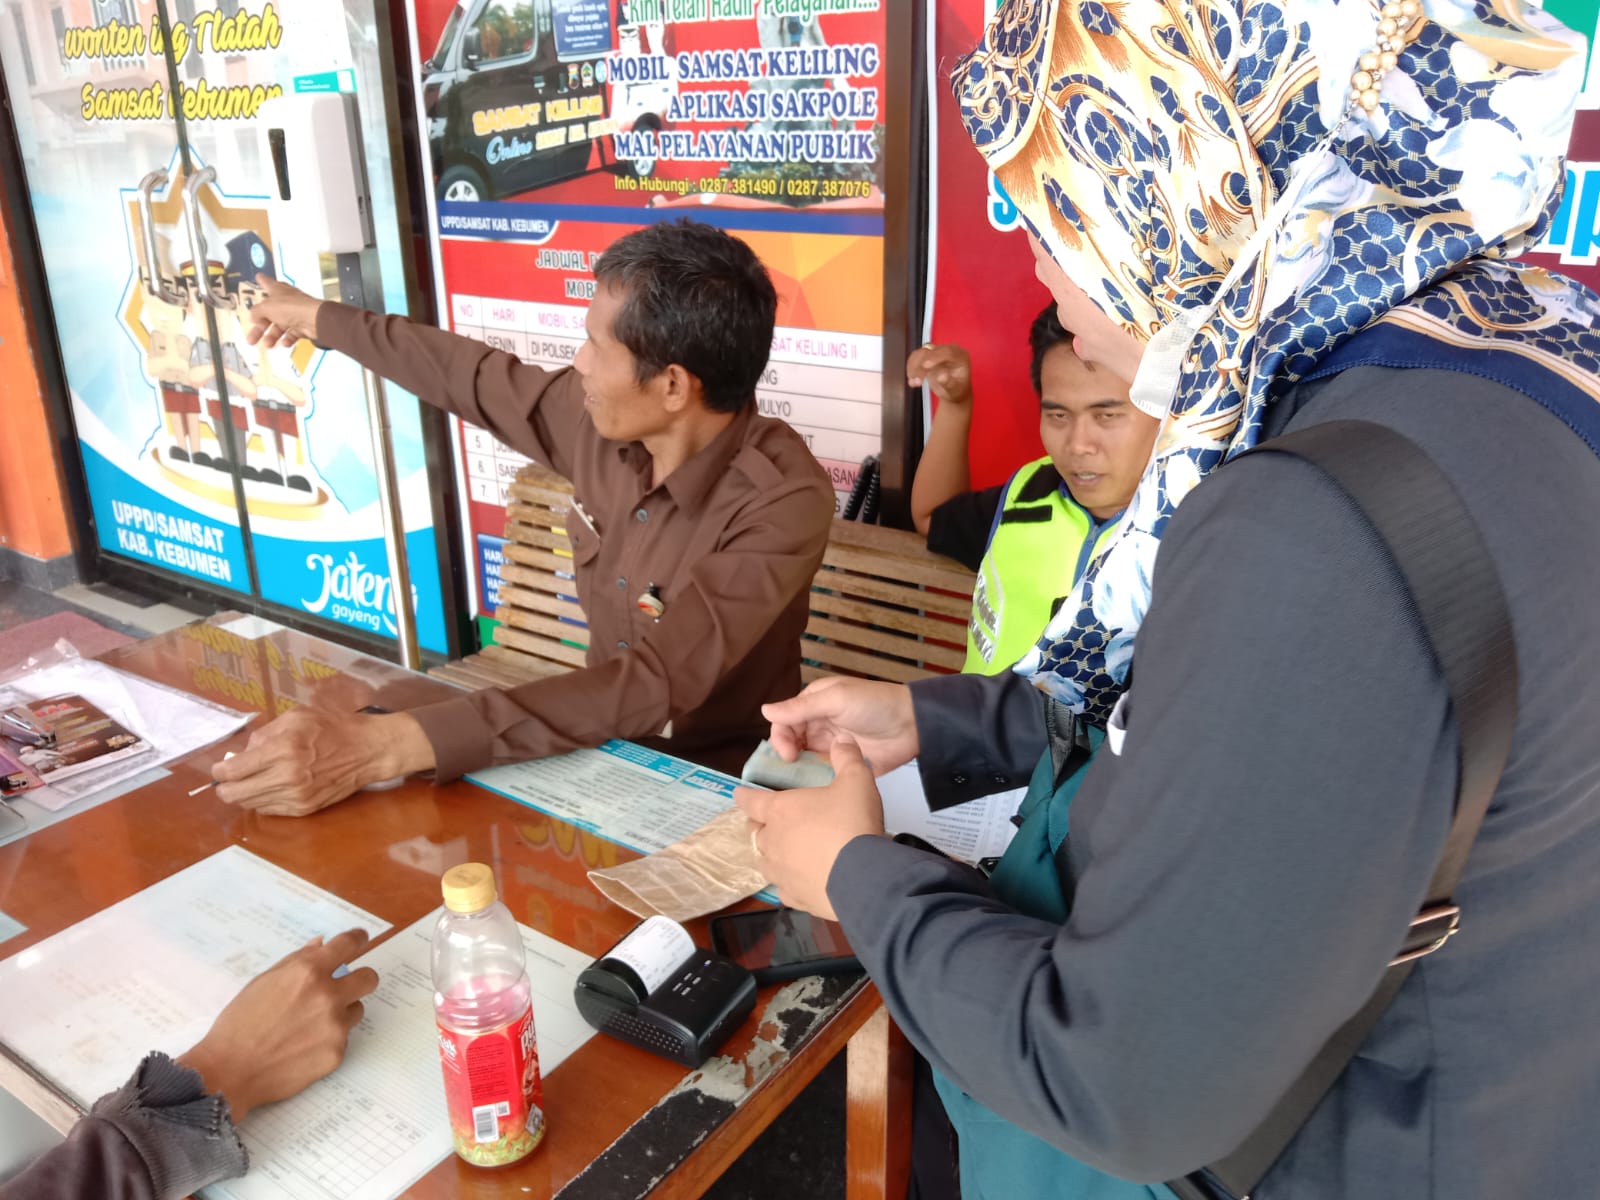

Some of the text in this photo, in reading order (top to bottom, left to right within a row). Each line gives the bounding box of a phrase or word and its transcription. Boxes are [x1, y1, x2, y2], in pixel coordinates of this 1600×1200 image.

[665, 0, 706, 21] Telah
[711, 0, 753, 18] Hadir
[64, 18, 146, 59] wonten
[150, 14, 191, 65] ig
[609, 47, 878, 81] MOBIL SAMSAT KELILING
[81, 80, 164, 121] Samsat
[668, 90, 876, 119] APLIKASI SAKPOLE
[615, 132, 656, 160] MAL
[660, 132, 787, 160] PELAYANAN
[791, 132, 874, 160] PUBLIK
[614, 175, 637, 191] Info
[639, 175, 689, 195] Hubungi
[699, 177, 777, 195] 0287.381490
[787, 179, 870, 198] 0287.387076
[492, 217, 511, 231] KAB.
[511, 218, 549, 233] KEBUMEN
[536, 250, 588, 270] JADWAL
[566, 280, 598, 298] MOB
[460, 304, 473, 317] NO
[492, 308, 515, 322] HARI
[538, 312, 569, 329] MOBIL
[531, 341, 541, 356] DI
[795, 338, 848, 359] KELILING
[112, 500, 224, 553] UPPD/SAMSAT
[117, 527, 231, 582] KAB. KEBUMEN
[332, 604, 380, 631] gayeng
